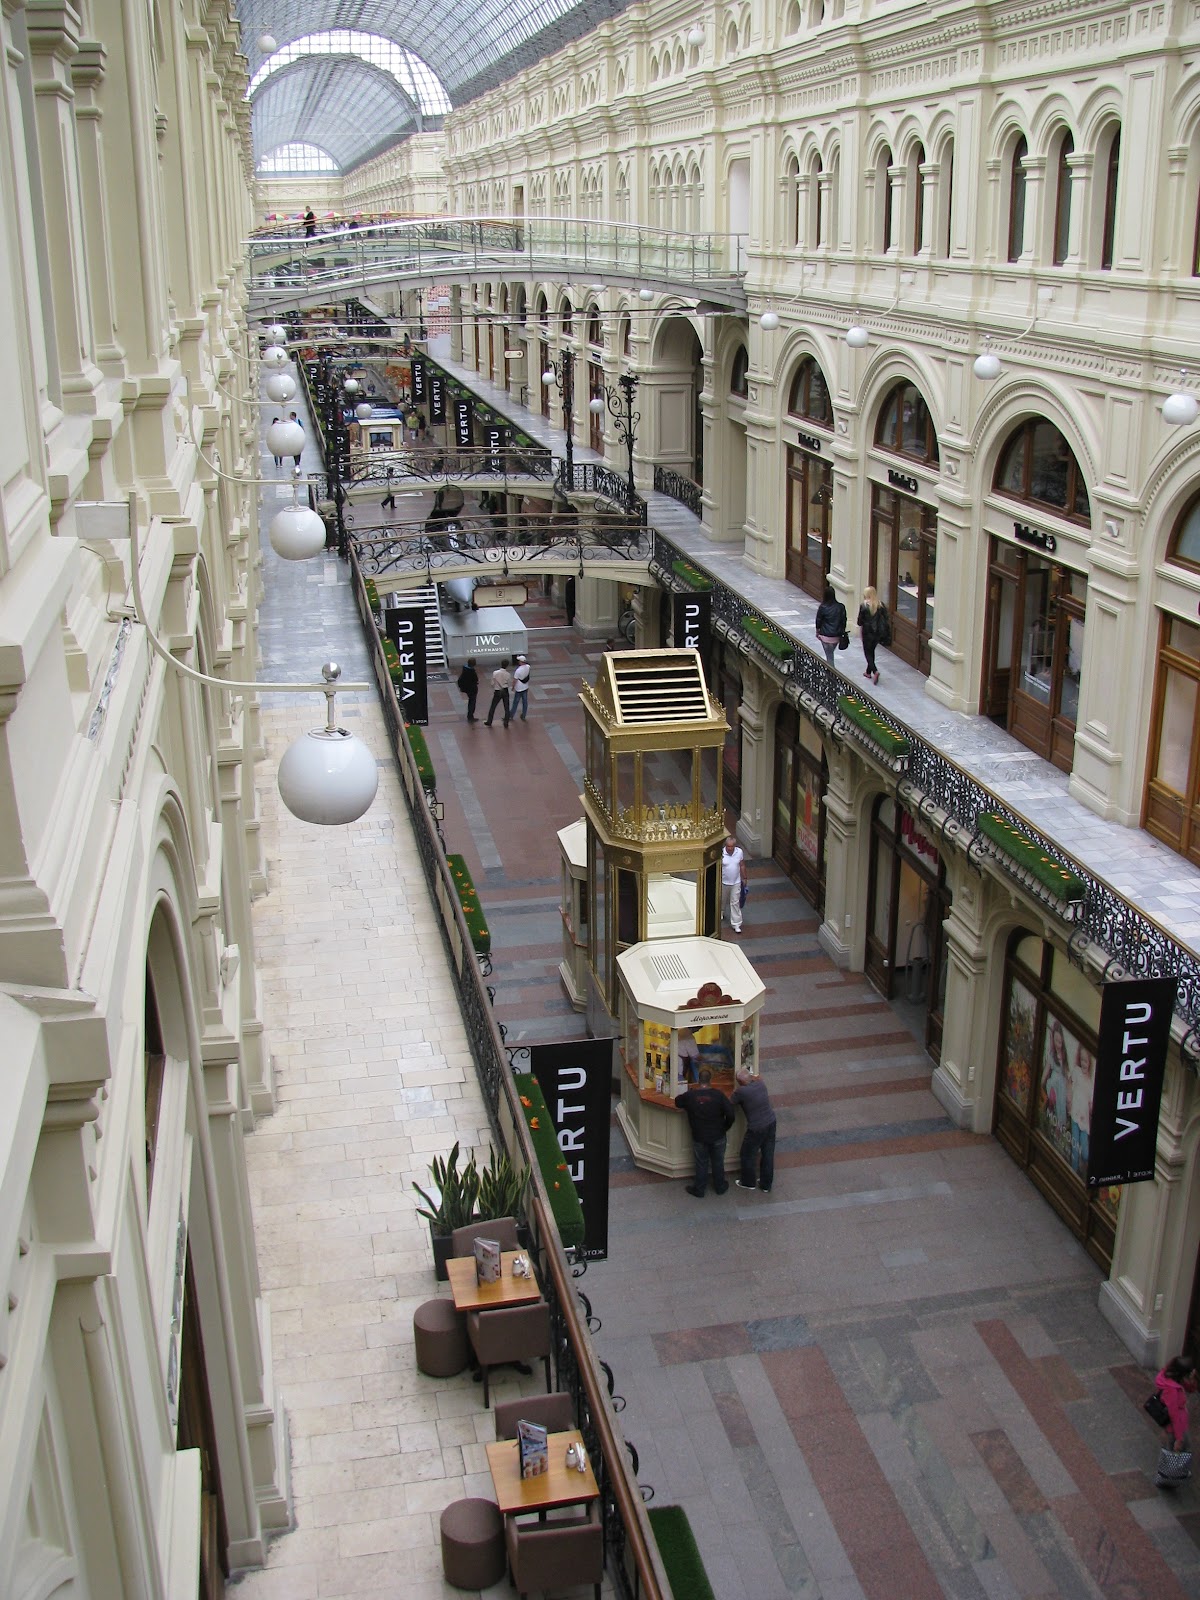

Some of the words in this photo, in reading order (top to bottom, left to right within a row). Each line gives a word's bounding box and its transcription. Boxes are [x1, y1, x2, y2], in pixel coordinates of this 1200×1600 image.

[433, 381, 441, 415] VERTU
[459, 405, 469, 444] VERTU
[475, 635, 500, 647] IWC
[685, 604, 700, 648] RTU
[398, 620, 415, 701] VERTU
[690, 1014, 729, 1022] Мороженое
[1113, 1002, 1152, 1141] VERTU
[557, 1066, 587, 1205] ERTU
[1089, 1176, 1096, 1185] 2
